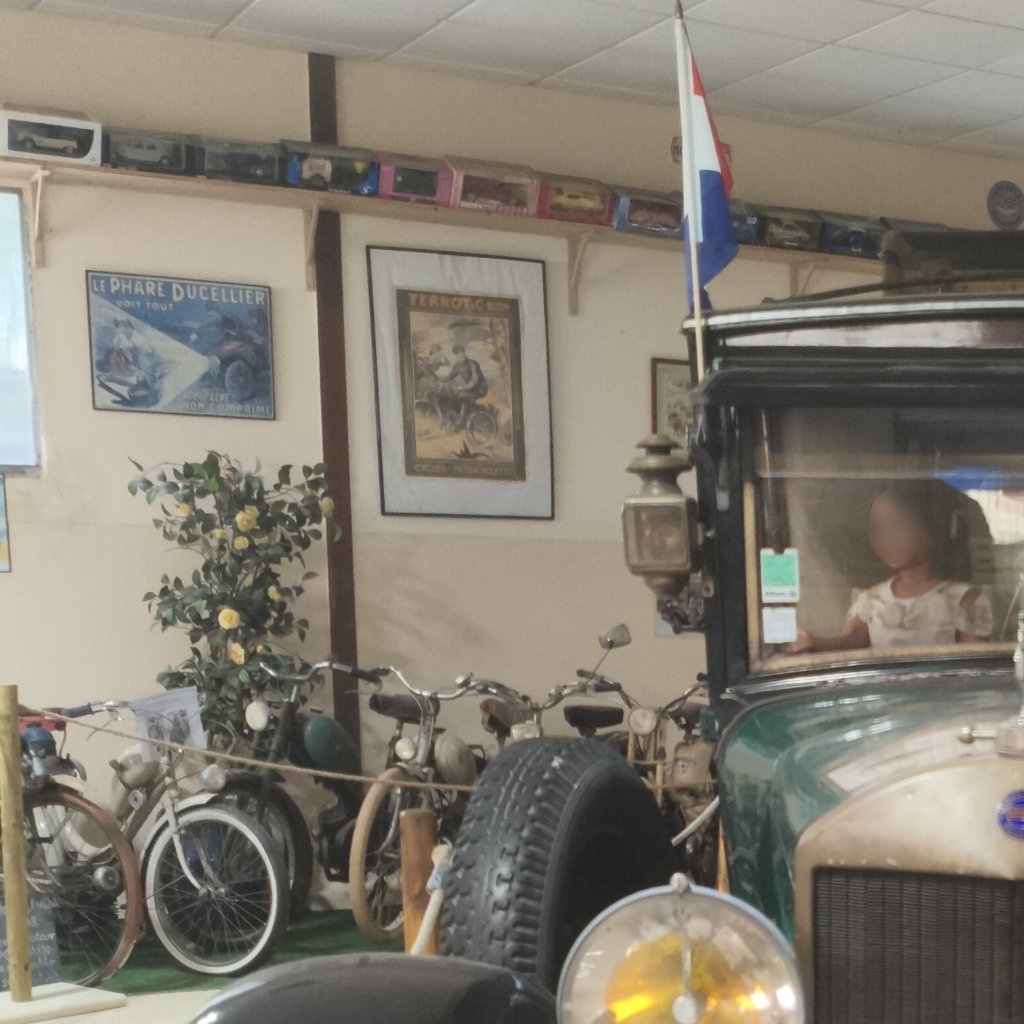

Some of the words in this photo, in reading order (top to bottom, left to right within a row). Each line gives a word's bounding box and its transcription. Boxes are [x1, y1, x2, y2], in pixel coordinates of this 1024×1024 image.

[93, 279, 106, 292] LE
[109, 277, 166, 297] PHARE
[171, 282, 266, 305] DUCELLIER
[145, 302, 175, 312] TOUT
